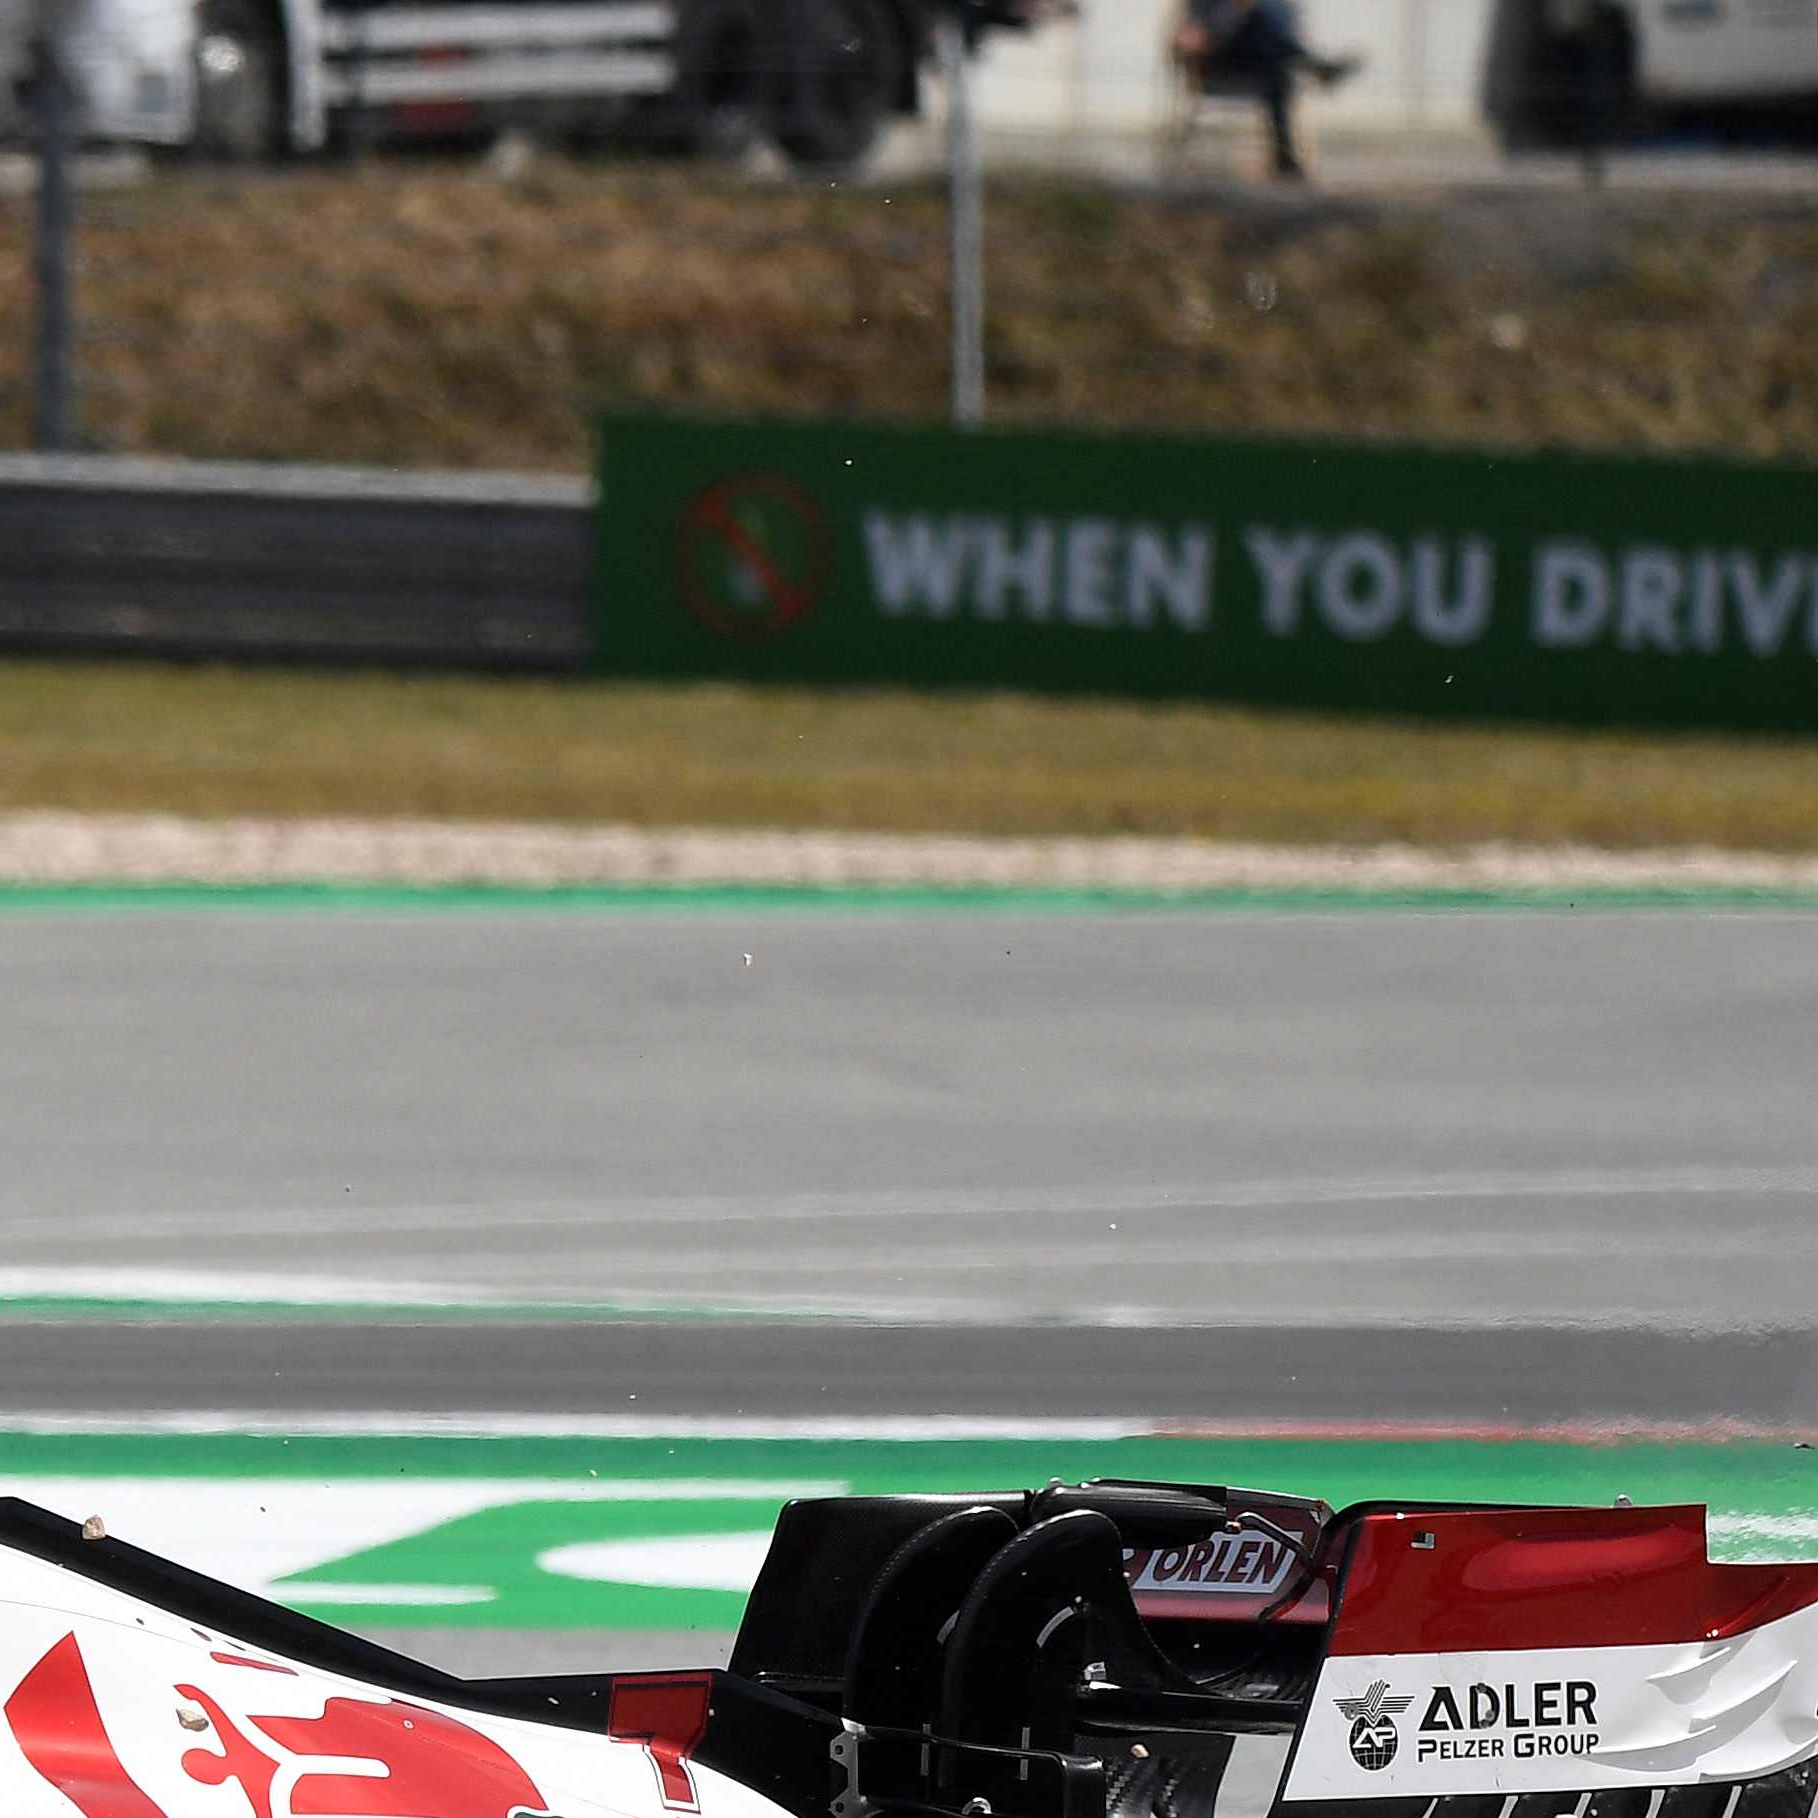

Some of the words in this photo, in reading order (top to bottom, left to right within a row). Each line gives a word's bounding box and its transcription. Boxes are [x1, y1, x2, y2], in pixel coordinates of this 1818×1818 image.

[863, 510, 1212, 628] WHEN
[1245, 527, 1492, 645] YOU
[1152, 1540, 1283, 1585] ORLEN
[1418, 1680, 1598, 1732] ADLER
